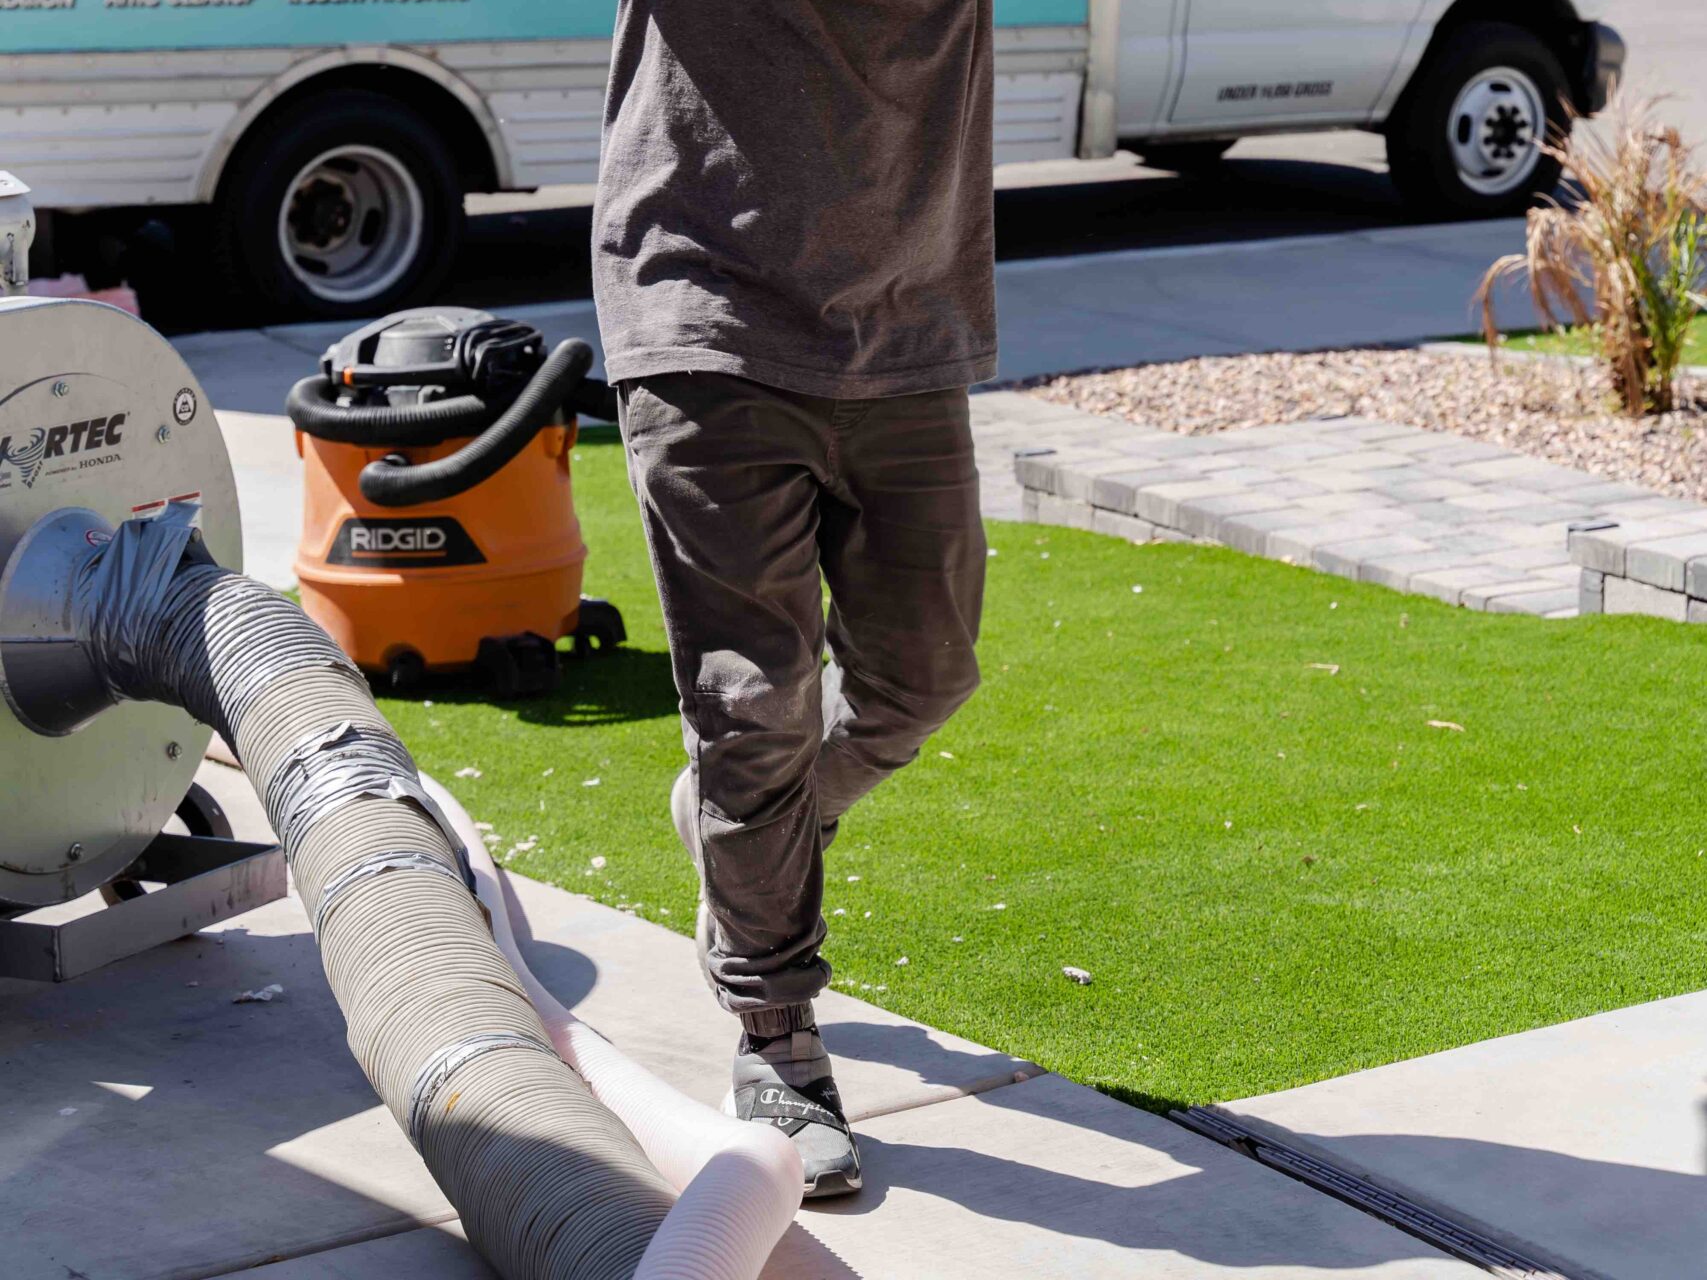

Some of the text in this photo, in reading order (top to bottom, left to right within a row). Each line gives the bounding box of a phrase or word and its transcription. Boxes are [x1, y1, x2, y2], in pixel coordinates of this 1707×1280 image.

[79, 453, 122, 469] HONDA
[351, 526, 446, 551] RIDGID
[760, 1088, 837, 1117] Champion
